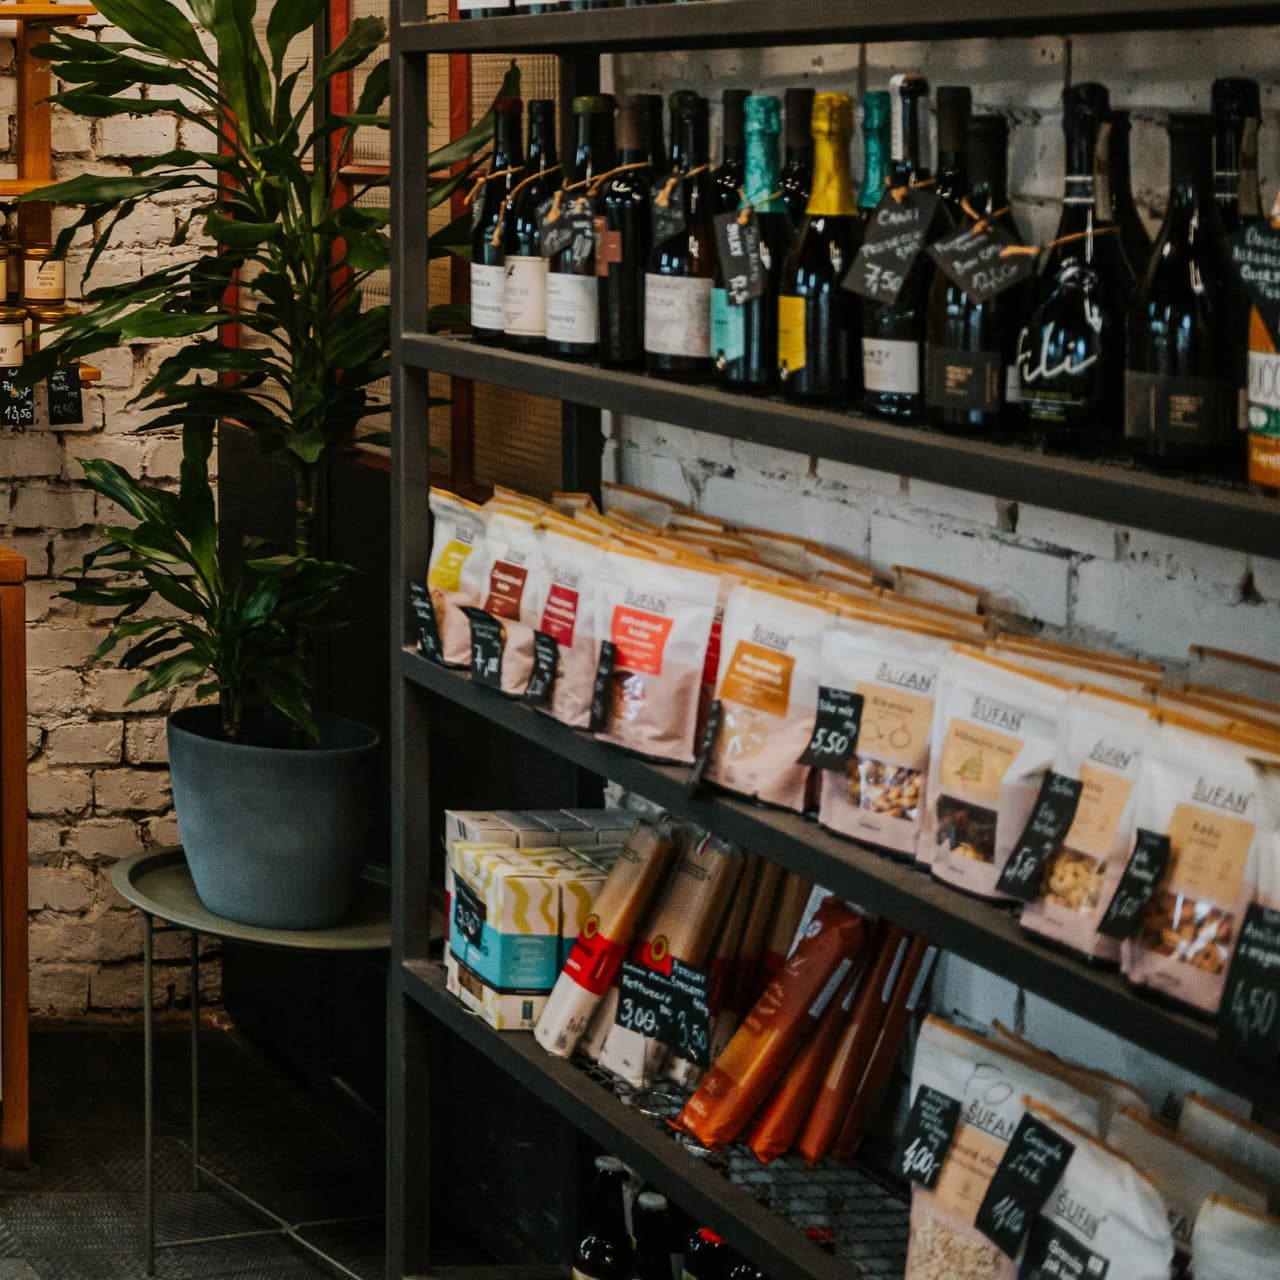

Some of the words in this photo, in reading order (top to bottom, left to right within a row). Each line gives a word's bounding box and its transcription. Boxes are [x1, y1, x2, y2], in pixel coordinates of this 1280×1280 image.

[863, 262, 903, 293] 7,50
[4, 406, 32, 424] 13,50
[875, 662, 936, 692] ŠUFAN
[972, 696, 1025, 731] ŠUFAN
[810, 727, 848, 757] 5,50
[1193, 777, 1254, 814] ŠUFAN
